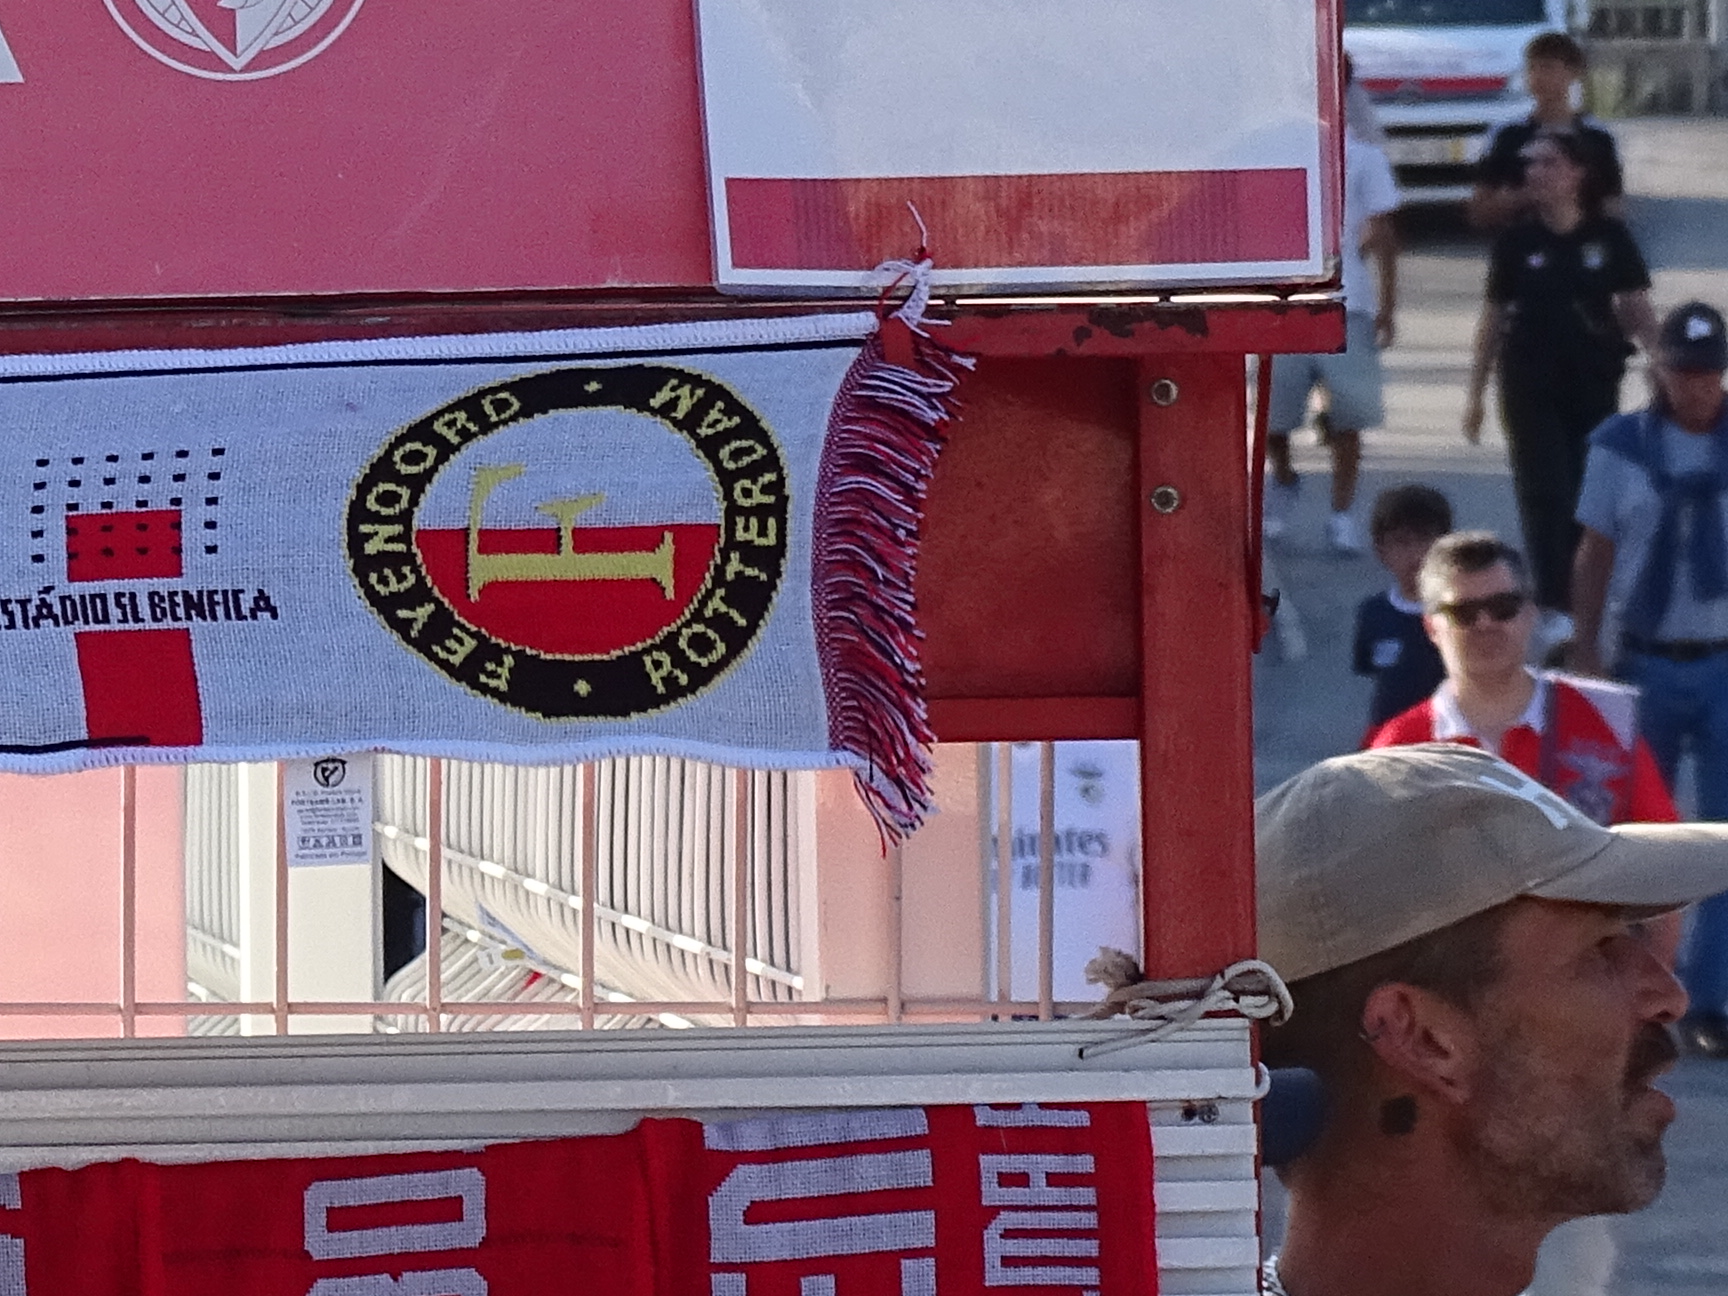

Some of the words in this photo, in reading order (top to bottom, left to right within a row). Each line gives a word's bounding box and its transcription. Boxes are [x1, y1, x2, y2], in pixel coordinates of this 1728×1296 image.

[116, 591, 145, 624] SL
[147, 588, 279, 623] BENFICA
[359, 391, 520, 692] FEYENOORD
[642, 378, 778, 695] ROTTERDAM
